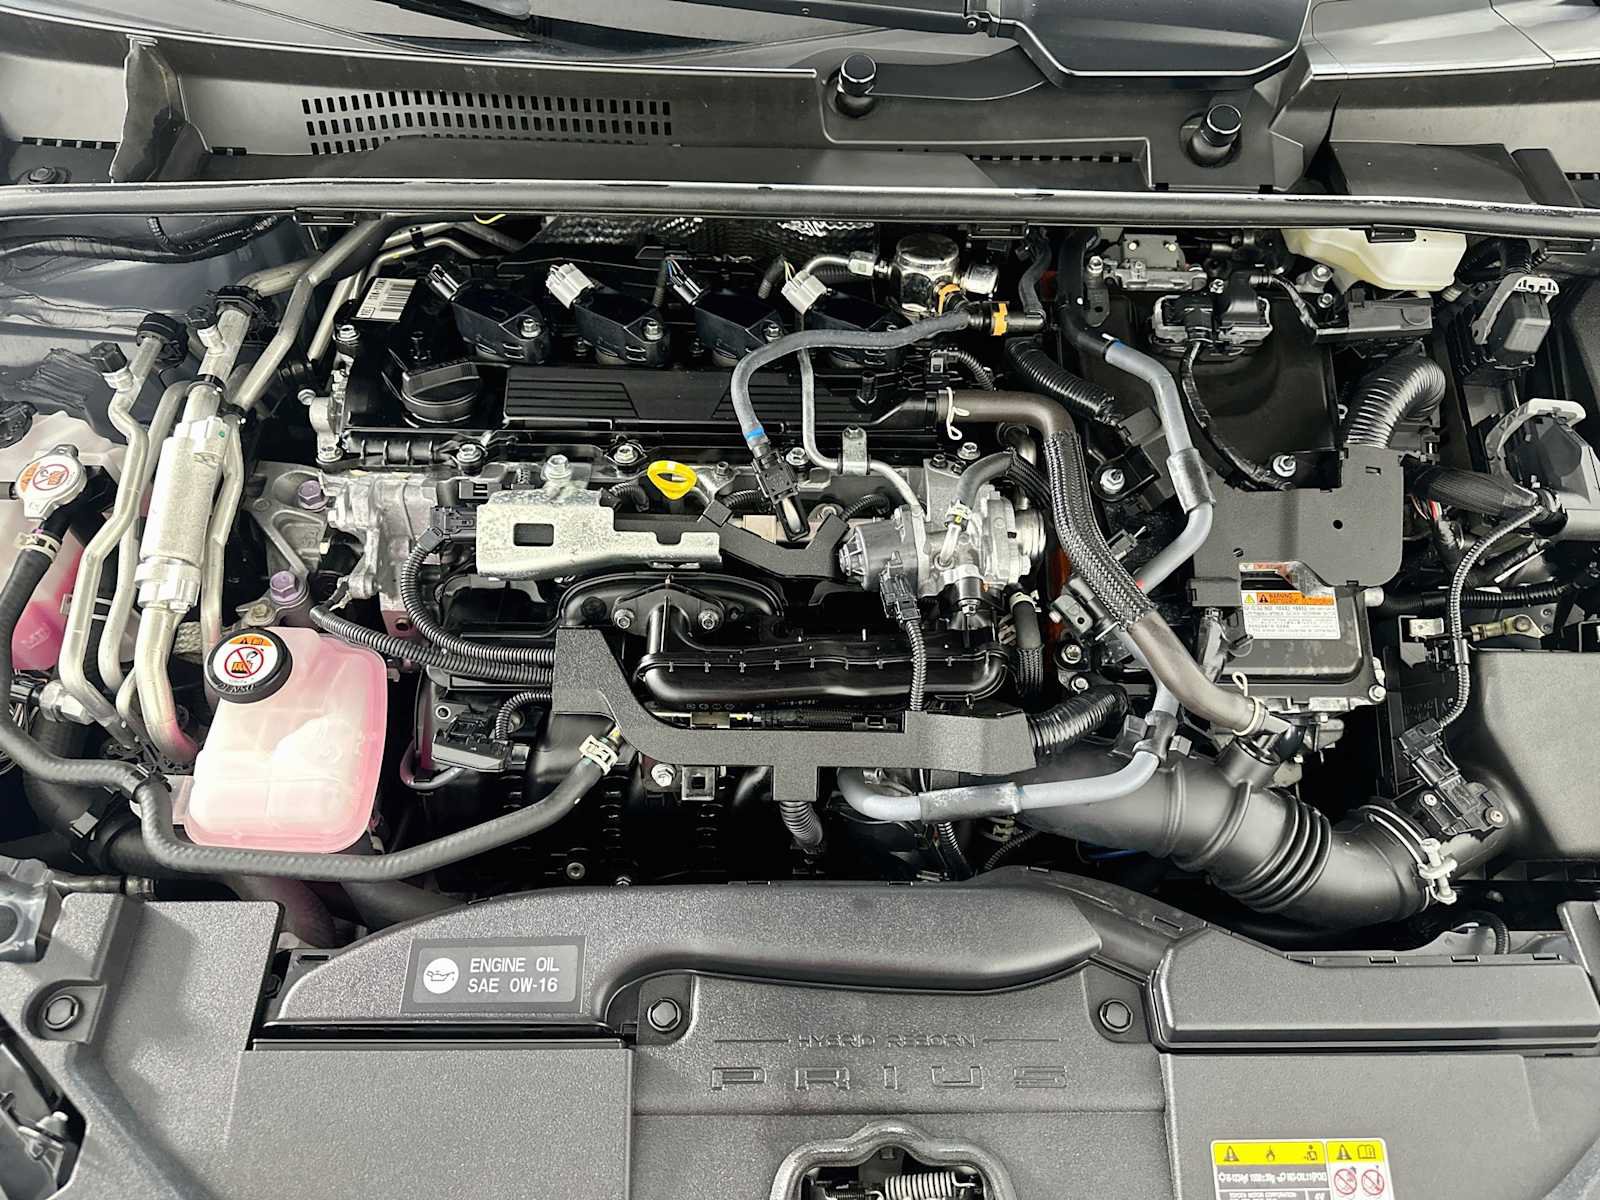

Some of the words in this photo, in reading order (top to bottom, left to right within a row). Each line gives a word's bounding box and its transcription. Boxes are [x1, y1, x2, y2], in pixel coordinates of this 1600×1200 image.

[470, 957, 526, 973] ENGINE
[535, 956, 560, 973] OIL
[467, 978, 499, 993] SAE
[509, 976, 559, 993] 0W-16
[798, 1034, 876, 1048] HYBRID
[887, 1034, 976, 1048] REBORN
[711, 1065, 1067, 1091] PRIUS
